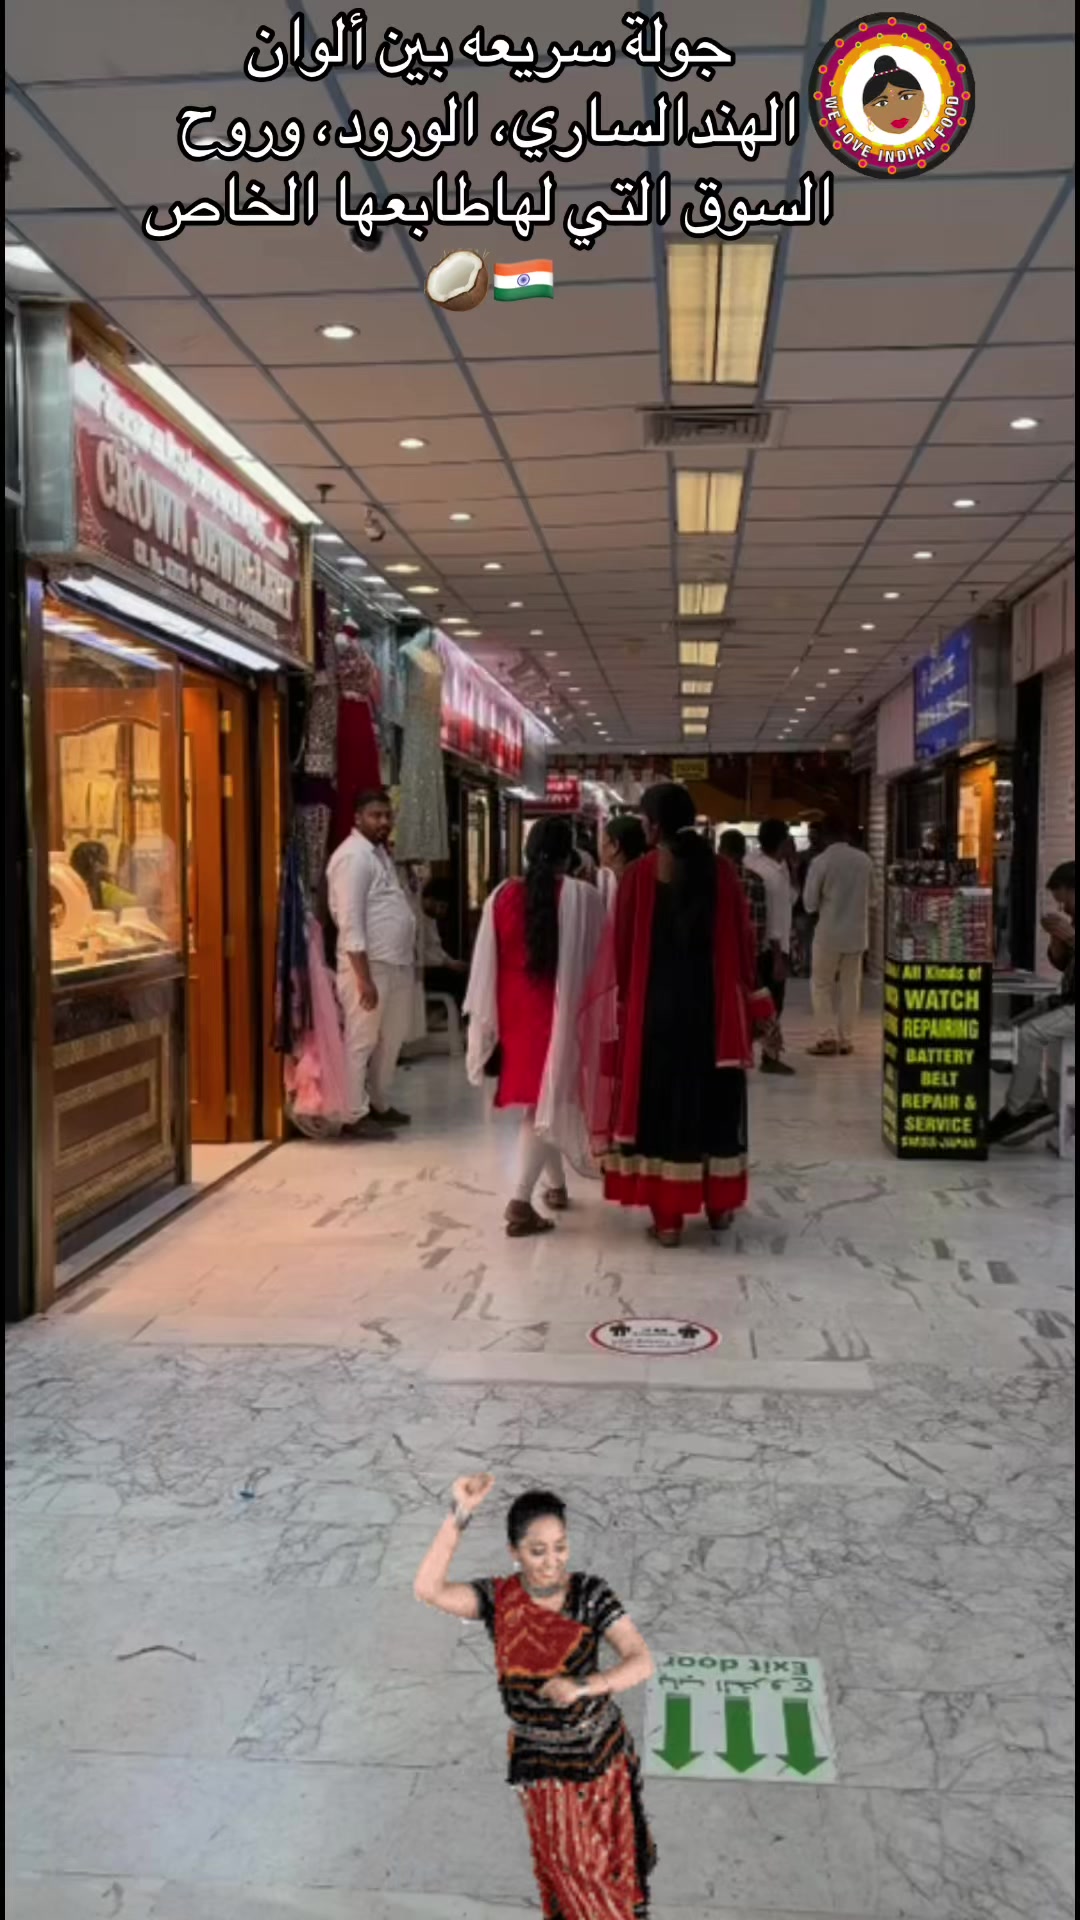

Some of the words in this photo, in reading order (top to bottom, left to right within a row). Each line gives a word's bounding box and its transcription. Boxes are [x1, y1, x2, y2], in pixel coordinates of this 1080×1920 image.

[96, 439, 188, 549] CROWN
[903, 965, 921, 980] All
[925, 965, 964, 980] Kinds
[967, 965, 982, 981] of
[904, 989, 980, 1011] WATCH
[903, 1018, 979, 1040] REPAIRING
[906, 1049, 975, 1064] BATTERY
[920, 1072, 959, 1087] BELT
[902, 1095, 959, 1111] REPAIR
[964, 1095, 977, 1111] &
[904, 1118, 972, 1134] SERVICE
[663, 1656, 739, 1673] door
[749, 1658, 809, 1676] Exit
